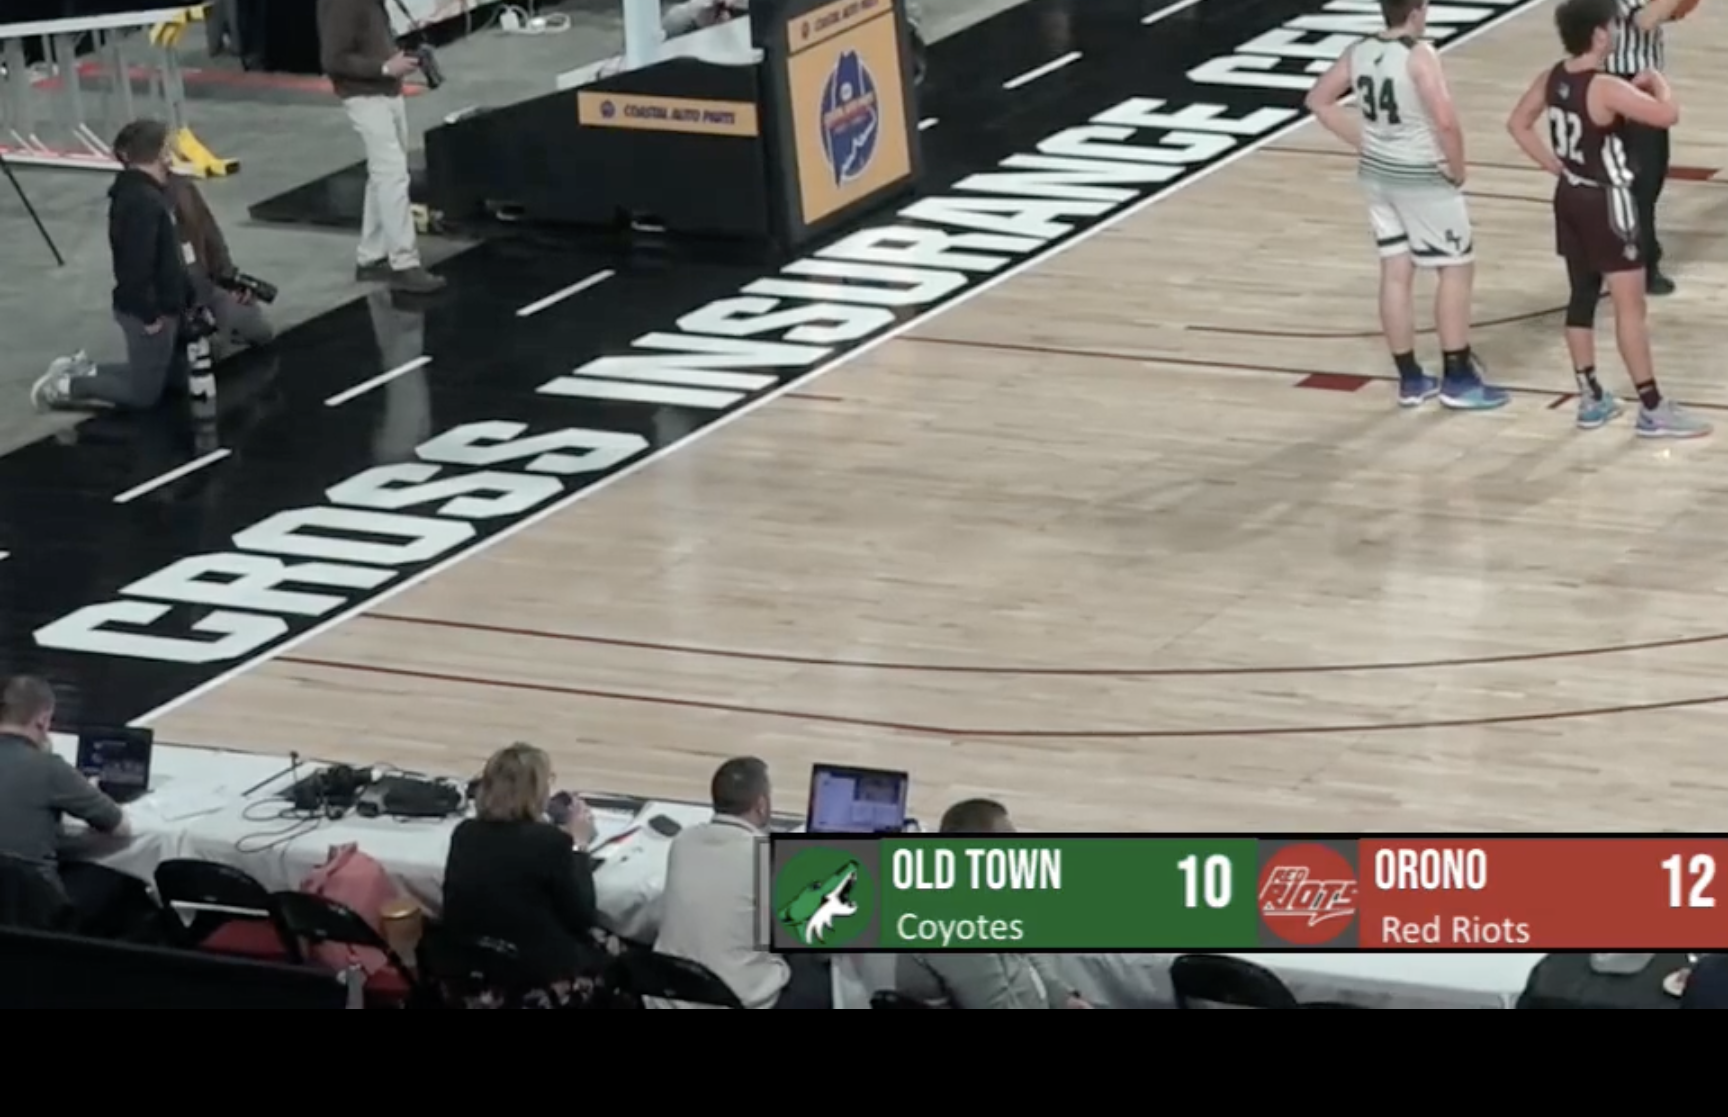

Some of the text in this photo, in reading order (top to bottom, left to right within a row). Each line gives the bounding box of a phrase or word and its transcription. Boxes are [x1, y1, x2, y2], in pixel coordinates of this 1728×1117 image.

[672, 108, 700, 122] AUTO
[1357, 75, 1401, 125] 34
[1549, 106, 1585, 165] 32
[33, 420, 651, 664] CROSS
[538, 99, 1212, 410] INSURANCE
